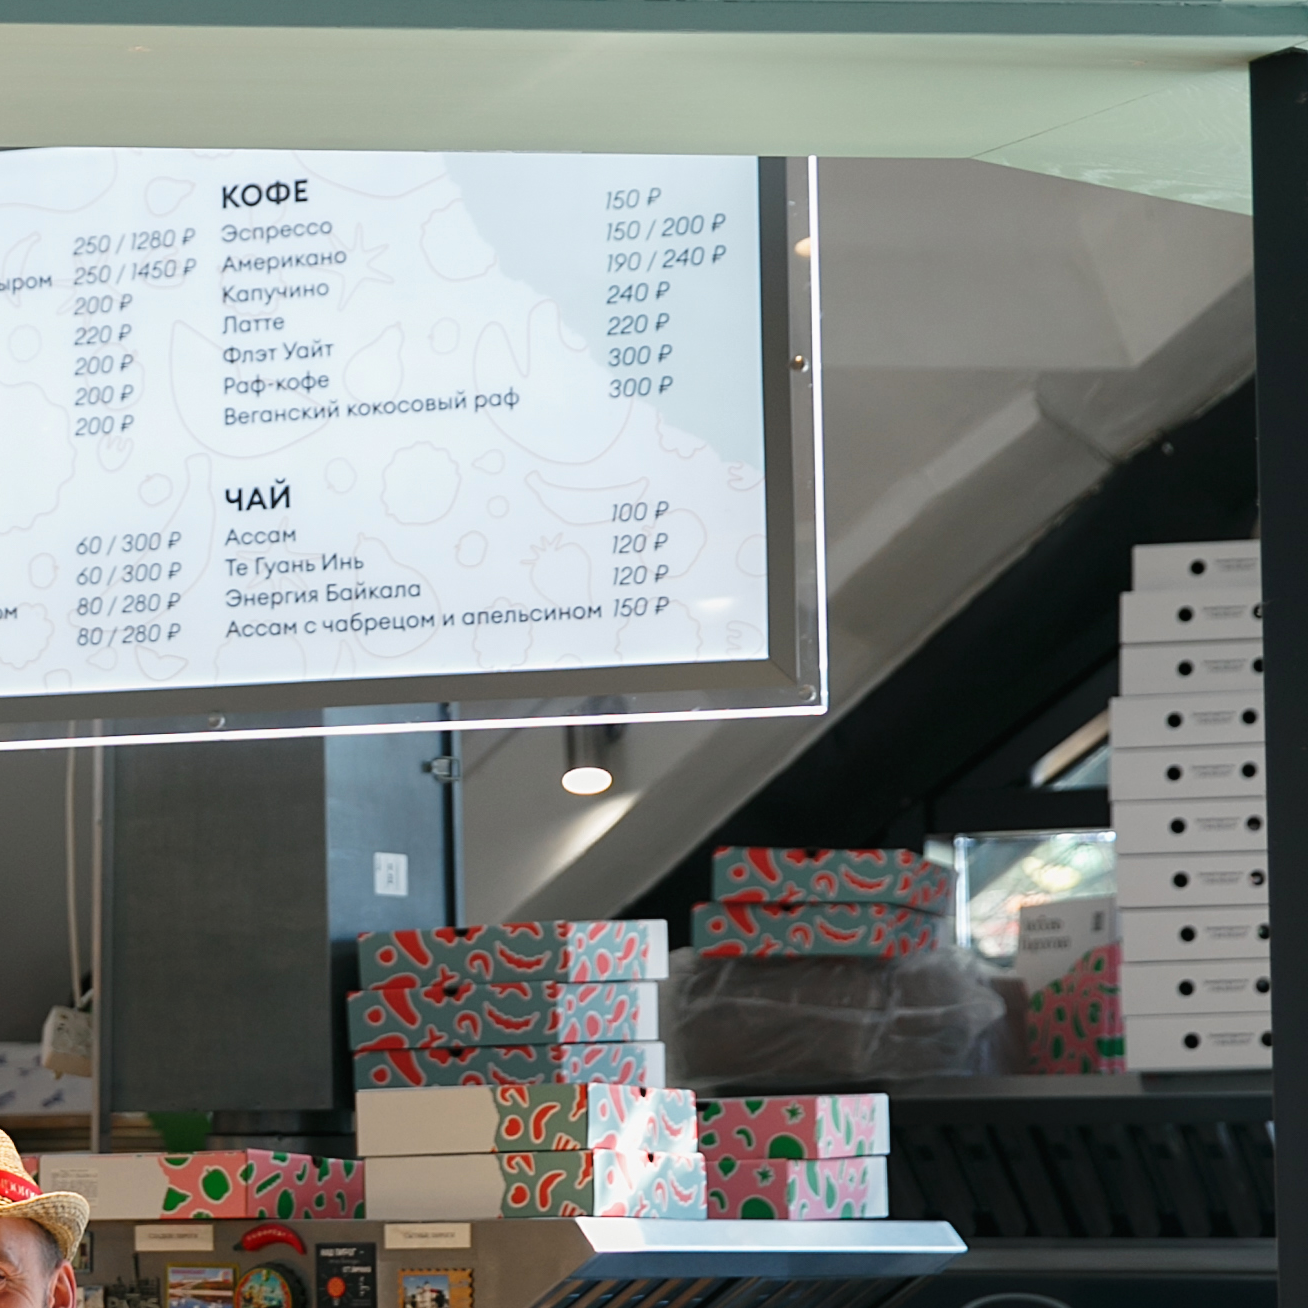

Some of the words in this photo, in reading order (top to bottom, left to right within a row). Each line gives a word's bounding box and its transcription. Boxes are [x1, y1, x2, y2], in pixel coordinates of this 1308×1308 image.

[221, 177, 310, 210] КОФЕ
[606, 188, 640, 210] 150
[221, 220, 333, 244] Эспрессо
[606, 220, 641, 242] 150
[660, 214, 705, 238] 200
[220, 250, 348, 275] Американо
[607, 251, 642, 273] 190
[661, 245, 706, 270] 240
[221, 282, 330, 306] Капучино
[605, 282, 650, 306] 240
[221, 315, 285, 335] Латте
[606, 313, 649, 337] 220
[222, 345, 278, 365] Флэт
[282, 339, 335, 361] Уайт
[607, 344, 652, 368] 300
[223, 370, 330, 398] Раф-кофе
[608, 376, 653, 399] 300
[223, 399, 340, 427] Веганский
[346, 390, 467, 417] кокосовый
[474, 386, 520, 413] раф
[224, 477, 292, 513] ЧАЙ
[611, 501, 649, 523] 100
[224, 528, 297, 547] Ассам
[612, 533, 648, 555] 120
[224, 557, 249, 577] Те
[254, 556, 317, 581] Гуань
[320, 552, 365, 572] Инь
[612, 564, 649, 587] 120
[225, 588, 319, 611] Энергия
[325, 580, 421, 603] Байкала
[613, 596, 650, 618] 150
[224, 619, 298, 639] Ассам
[303, 620, 317, 635] с
[321, 611, 436, 637] чабрецом
[441, 613, 456, 627] и
[461, 604, 603, 627] апельсином
